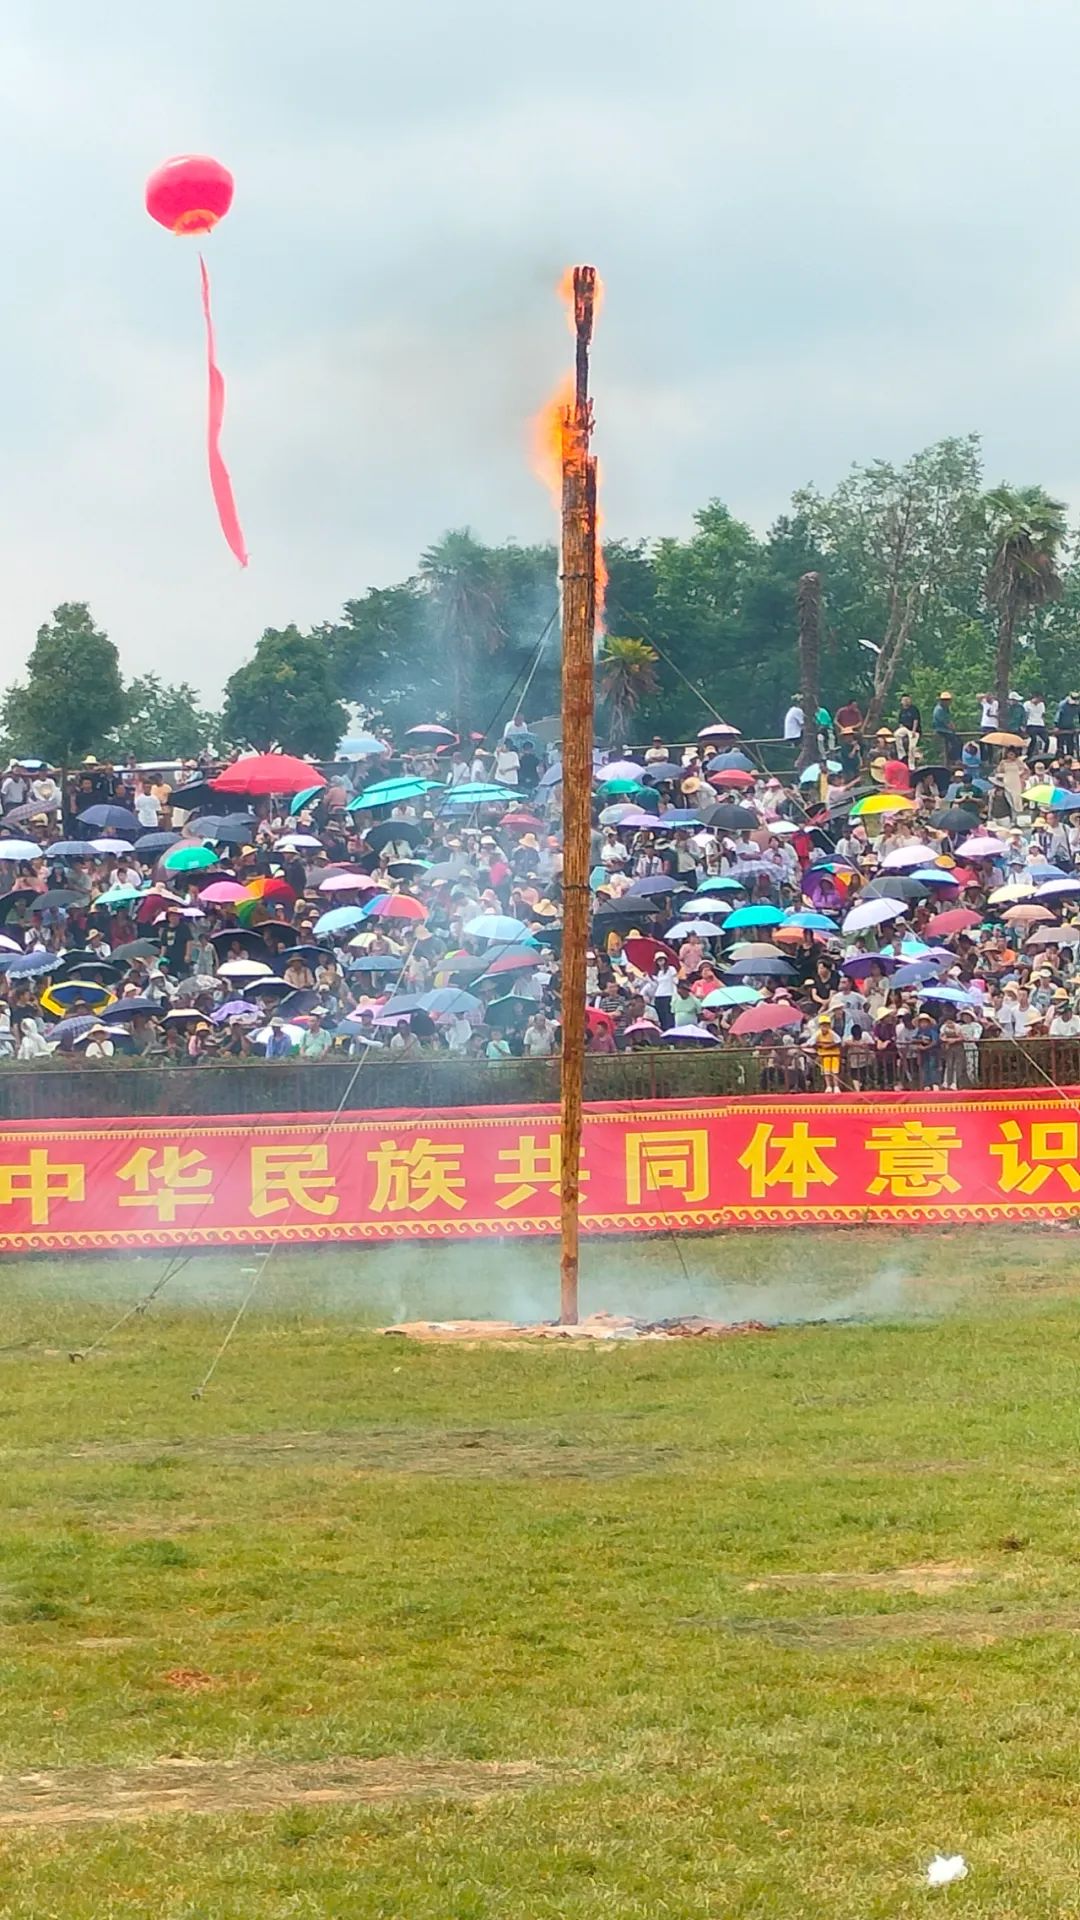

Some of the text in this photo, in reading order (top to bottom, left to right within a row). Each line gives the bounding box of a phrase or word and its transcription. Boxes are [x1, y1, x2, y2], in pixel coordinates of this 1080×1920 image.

[0, 1119, 1080, 1225] 中华民族共同体意识
